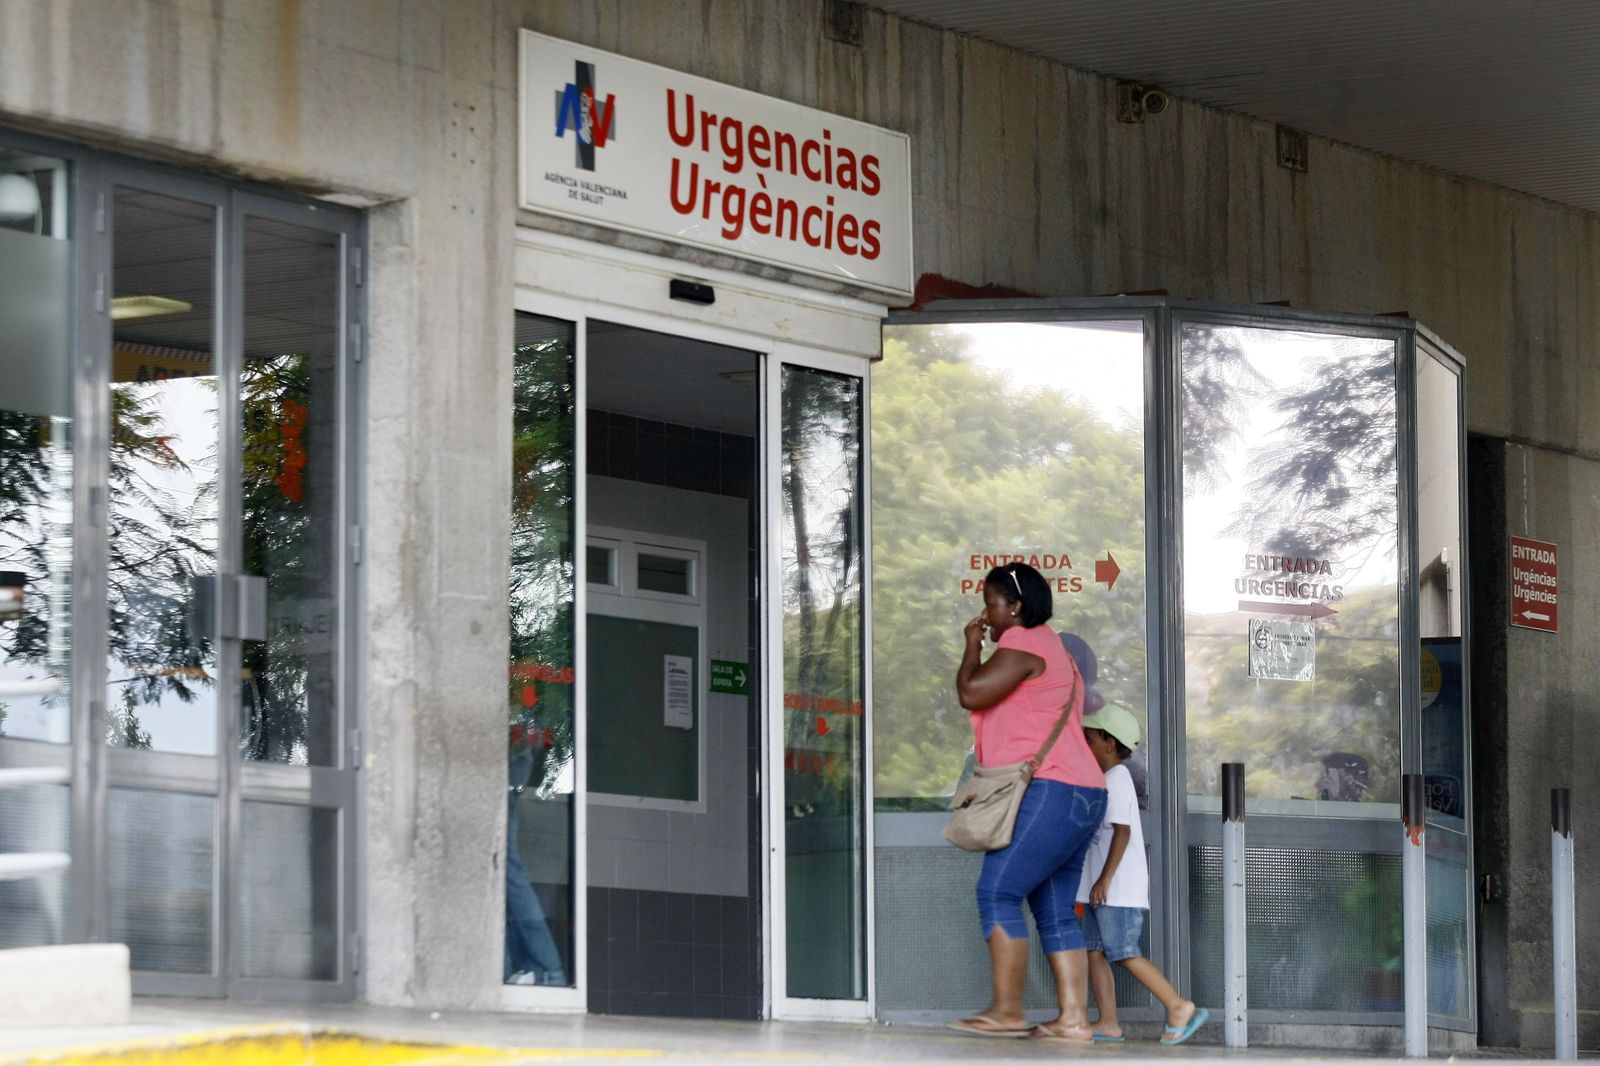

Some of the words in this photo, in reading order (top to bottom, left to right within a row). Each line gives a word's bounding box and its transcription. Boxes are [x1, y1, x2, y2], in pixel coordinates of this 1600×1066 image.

[667, 89, 881, 196] Urgencias
[568, 188, 579, 199] DE
[580, 192, 603, 205] SALUT
[580, 181, 627, 199] VALENCIANA
[670, 158, 881, 260] Urgències
[970, 554, 1072, 570] ENTRADA
[1245, 554, 1333, 576] ENTRADA
[1512, 545, 1556, 565] ENTRADA
[961, 577, 1083, 595] PATES
[1234, 578, 1344, 600] URGENCIAS
[1514, 584, 1557, 605] Urgències
